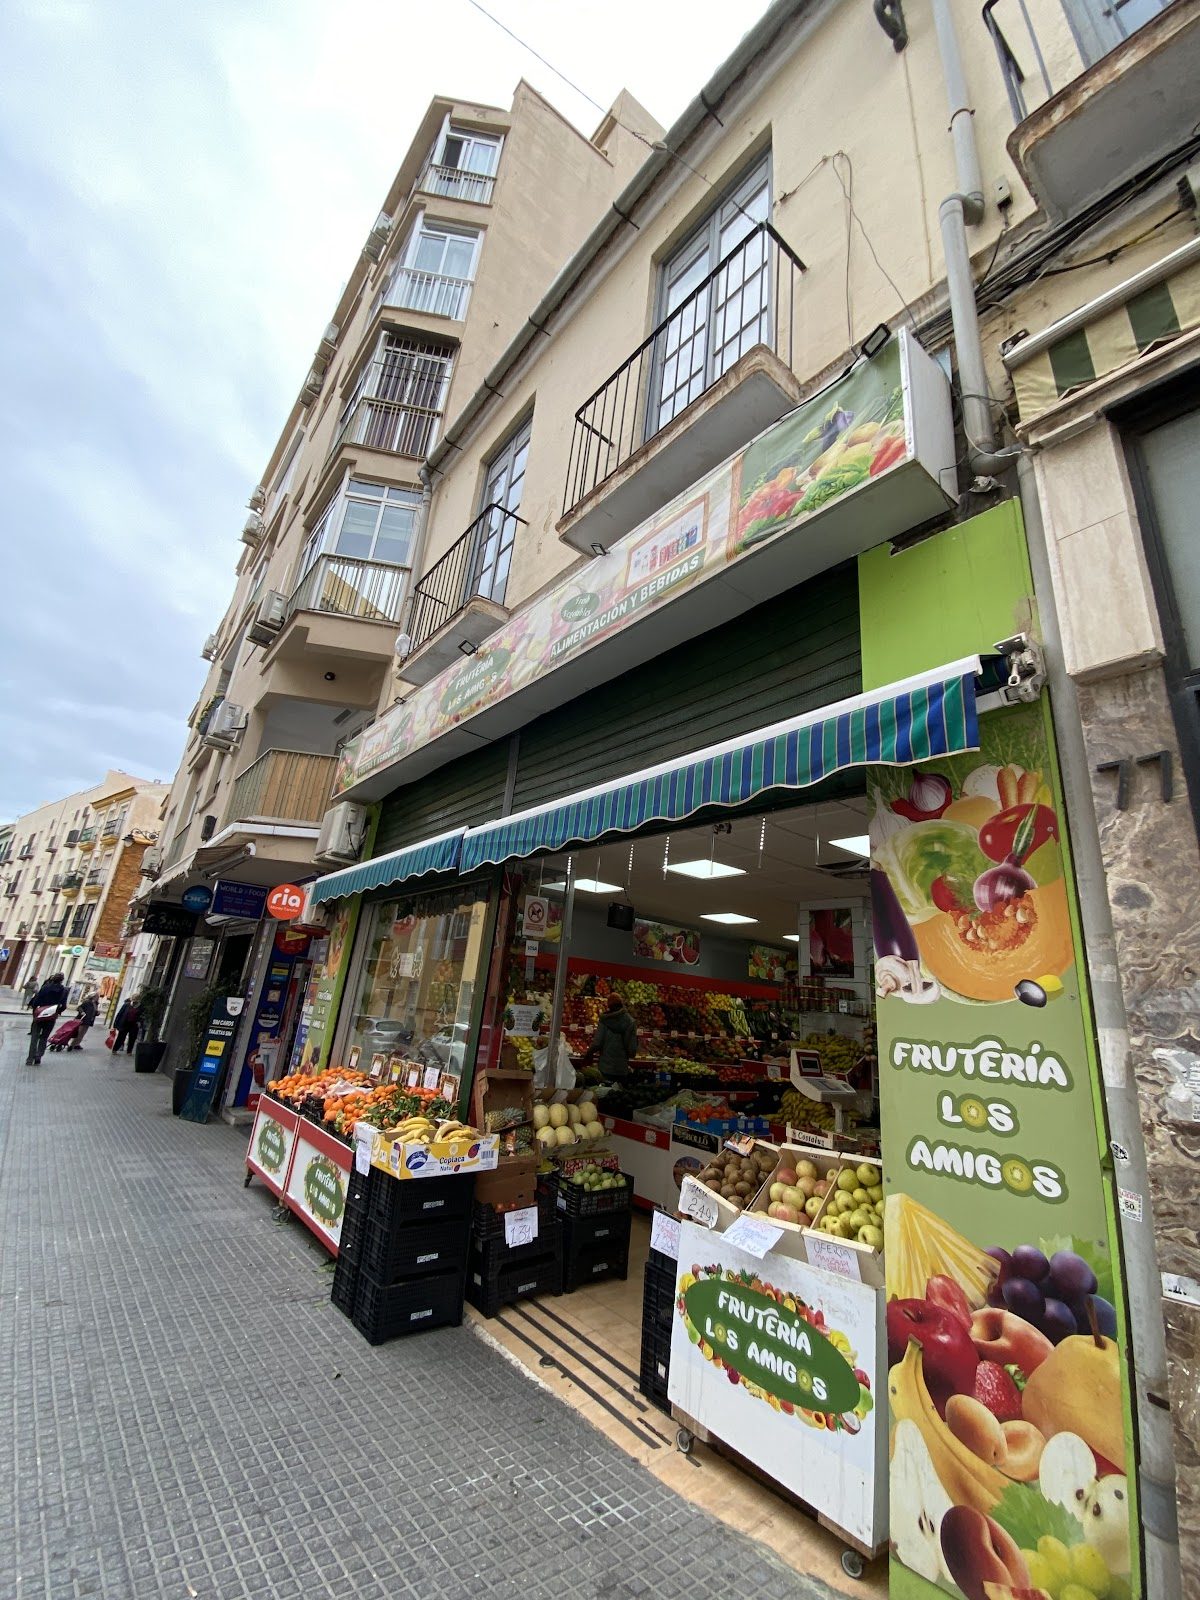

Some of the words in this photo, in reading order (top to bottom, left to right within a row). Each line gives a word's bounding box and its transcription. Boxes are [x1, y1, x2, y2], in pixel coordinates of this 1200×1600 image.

[550, 601, 628, 658] ALIMENTACIÓN
[630, 594, 639, 609] Y
[640, 555, 700, 601] BEBIDAS
[220, 885, 243, 895] WORLD
[248, 888, 266, 897] FOOD
[271, 888, 301, 908] ria
[892, 1039, 1068, 1088] FRUTERÍA
[941, 1095, 1014, 1132] LOS
[909, 1140, 1063, 1199] AMIGOS
[718, 1290, 812, 1357] FRUTERÍA
[705, 1317, 739, 1351] LOS
[747, 1341, 828, 1401] AMIGOS
